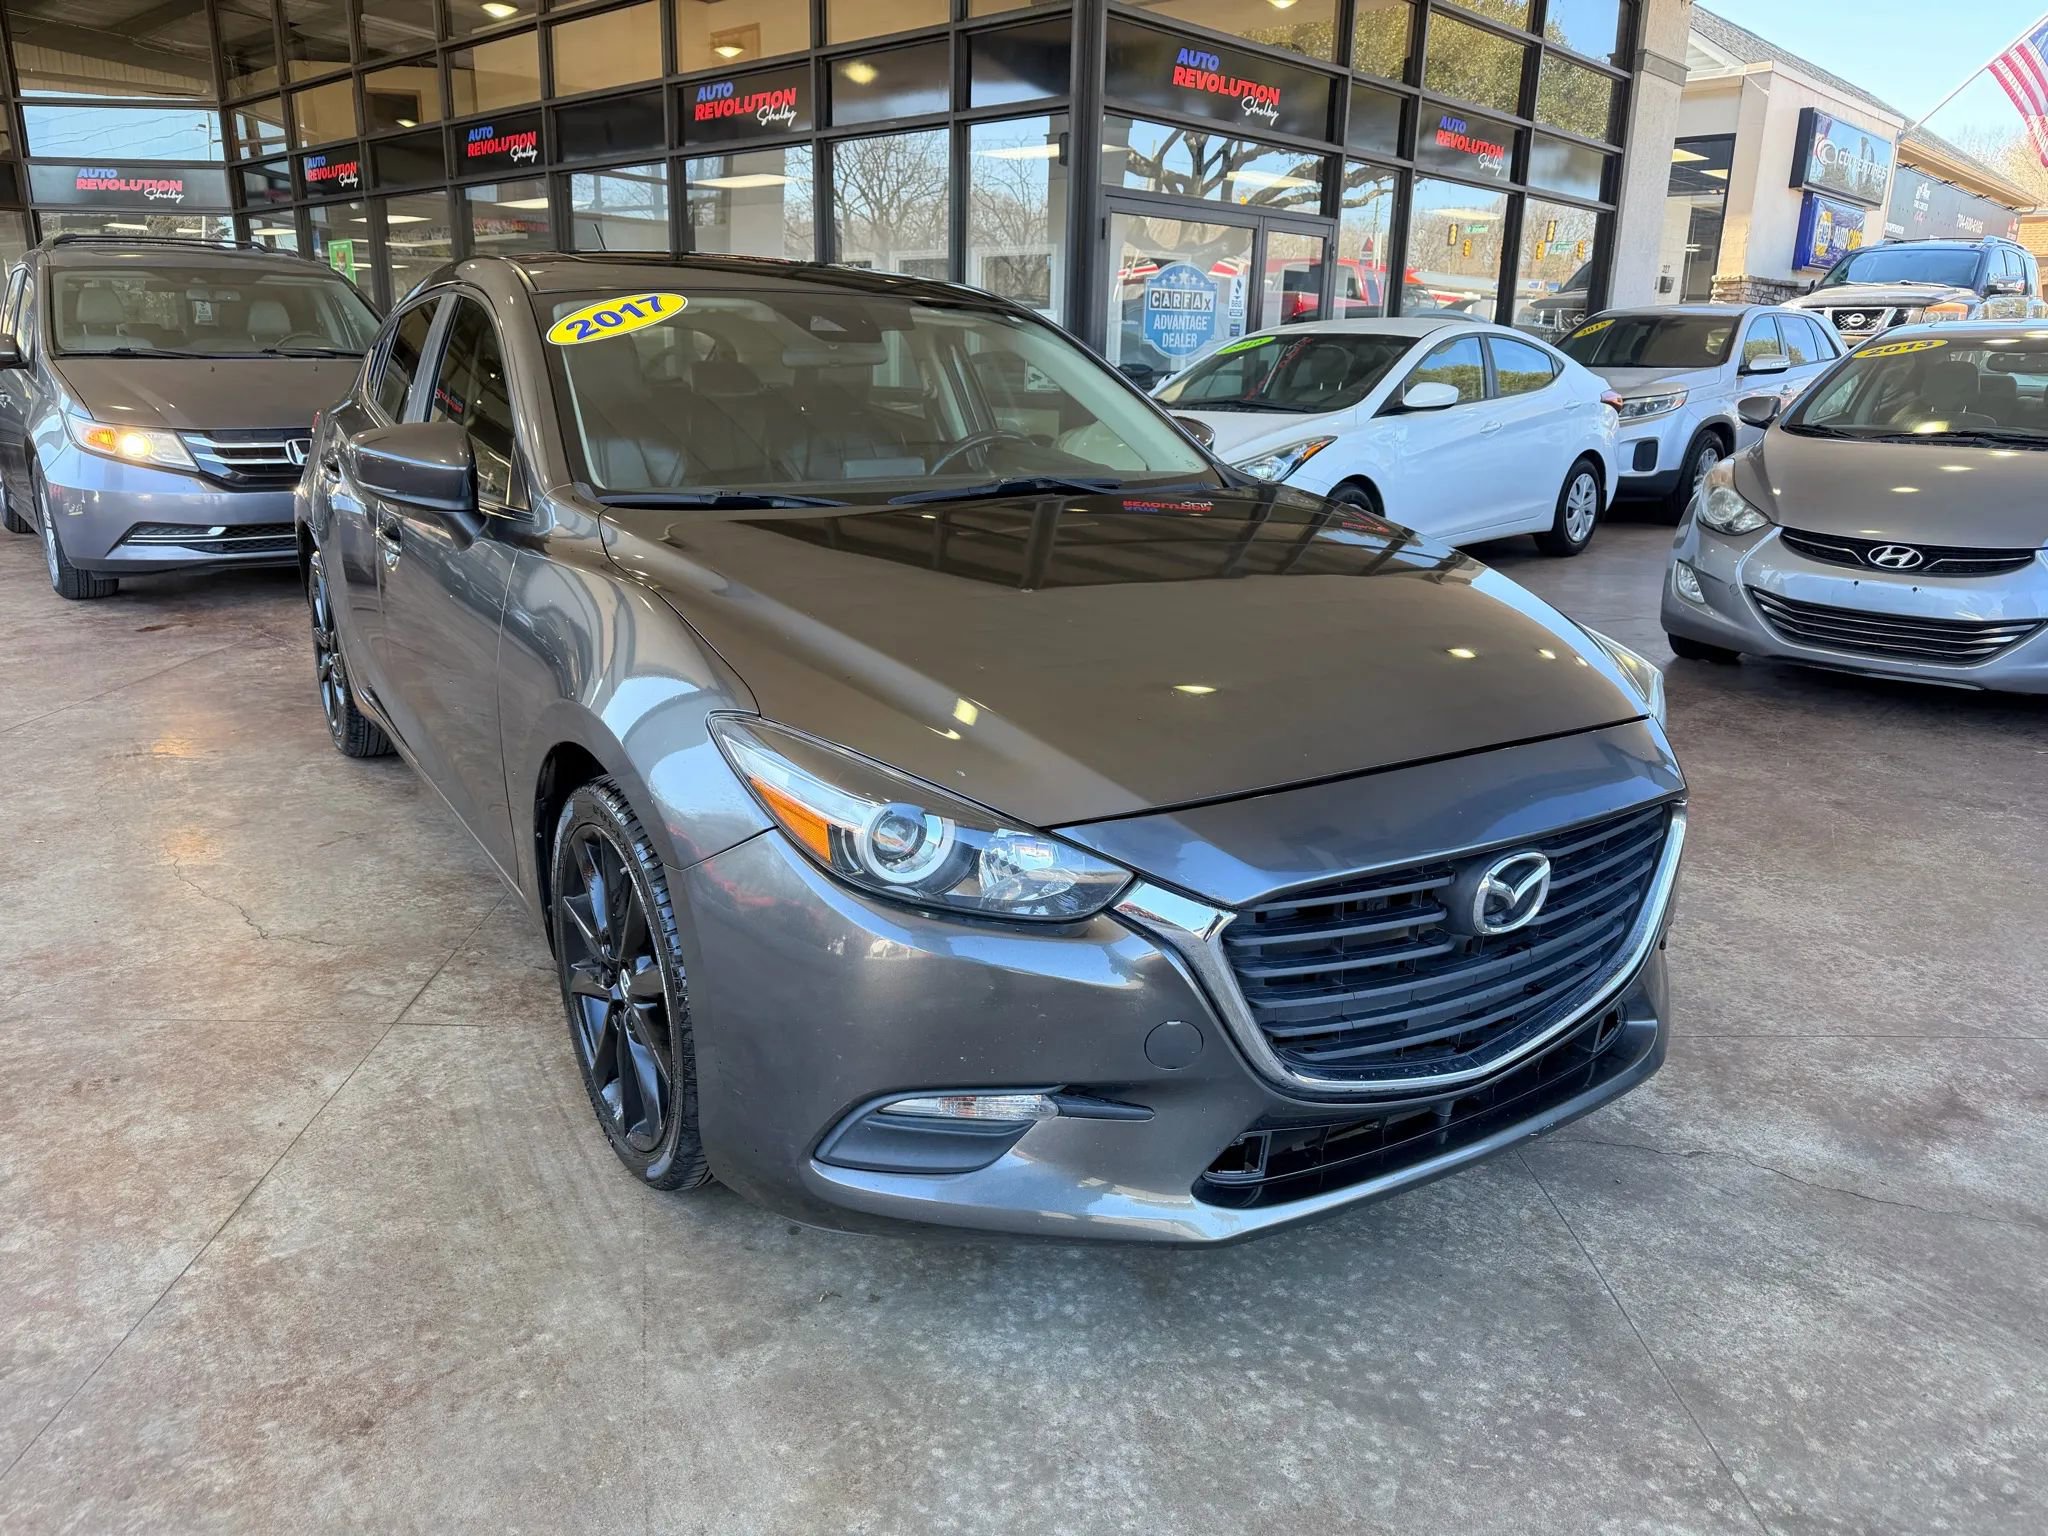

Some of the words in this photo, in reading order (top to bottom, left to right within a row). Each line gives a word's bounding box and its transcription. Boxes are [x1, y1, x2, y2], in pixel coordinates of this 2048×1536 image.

[1177, 48, 1220, 71] AUTO
[697, 81, 734, 102] AUTO
[1173, 66, 1280, 105] REVOLUTION
[695, 87, 797, 120] REVOLUTION
[757, 101, 797, 127] Shelby
[1242, 96, 1279, 126] Shelby
[468, 126, 494, 142] AUTO
[1440, 115, 1467, 133] AUTO
[467, 131, 537, 157] REVOLUTION
[510, 142, 538, 163] Shelby
[1435, 129, 1505, 159] REVOLUTION
[307, 161, 357, 182] REVOLUTION
[308, 156, 327, 169] AUTO
[78, 168, 118, 179] AUTO
[76, 179, 183, 192] REVOLUTION
[144, 188, 184, 203] Shelby
[1151, 291, 1212, 311] CARFAX
[566, 296, 664, 340] 2017
[1153, 314, 1208, 330] ADVANTAGE
[1162, 333, 1198, 348] DEALER
